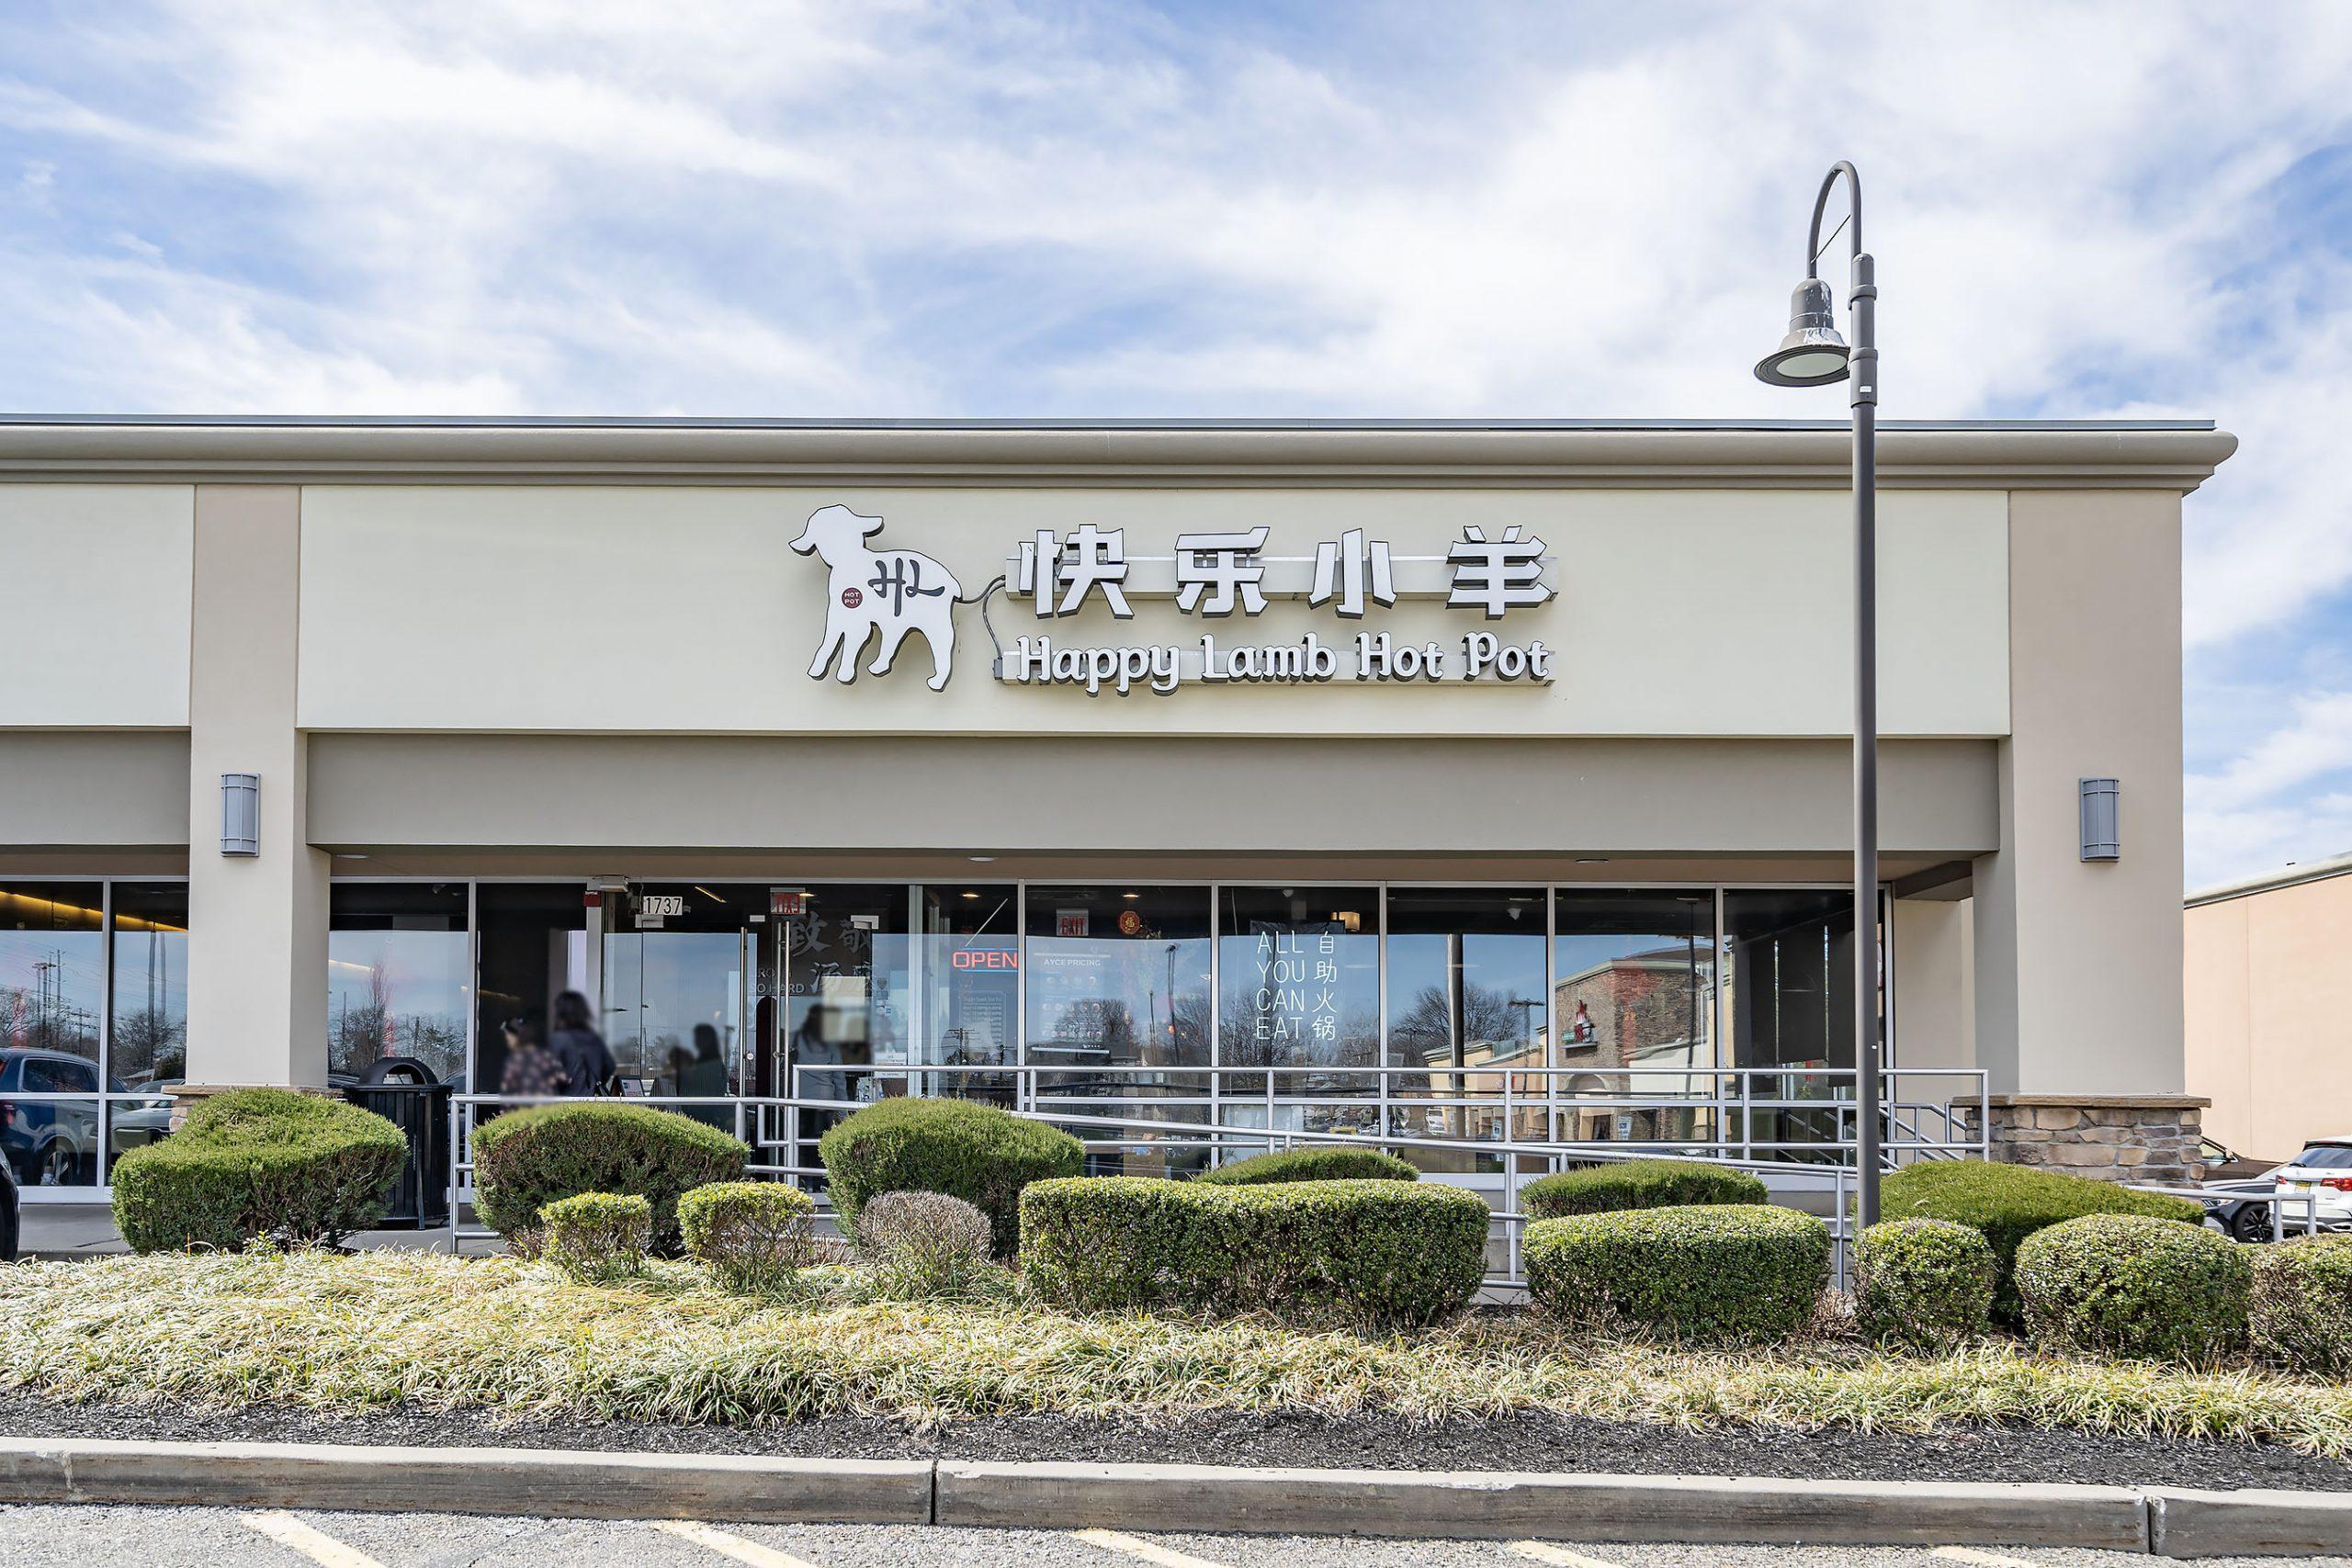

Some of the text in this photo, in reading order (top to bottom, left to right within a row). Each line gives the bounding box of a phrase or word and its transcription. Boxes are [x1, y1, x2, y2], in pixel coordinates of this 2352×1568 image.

[1018, 523, 1552, 620] 快乐小羊
[1016, 631, 1549, 696] Happy Lamb Hot Pot
[646, 897, 681, 915] 1737
[1061, 917, 1085, 935] EXIT
[1257, 930, 1305, 953] ALL
[953, 951, 1019, 968] OPEN
[1256, 959, 1305, 984] YOU
[1311, 930, 1338, 1041] 自助火锅
[1256, 987, 1305, 1011] CAN
[1256, 1016, 1303, 1040] EAT
